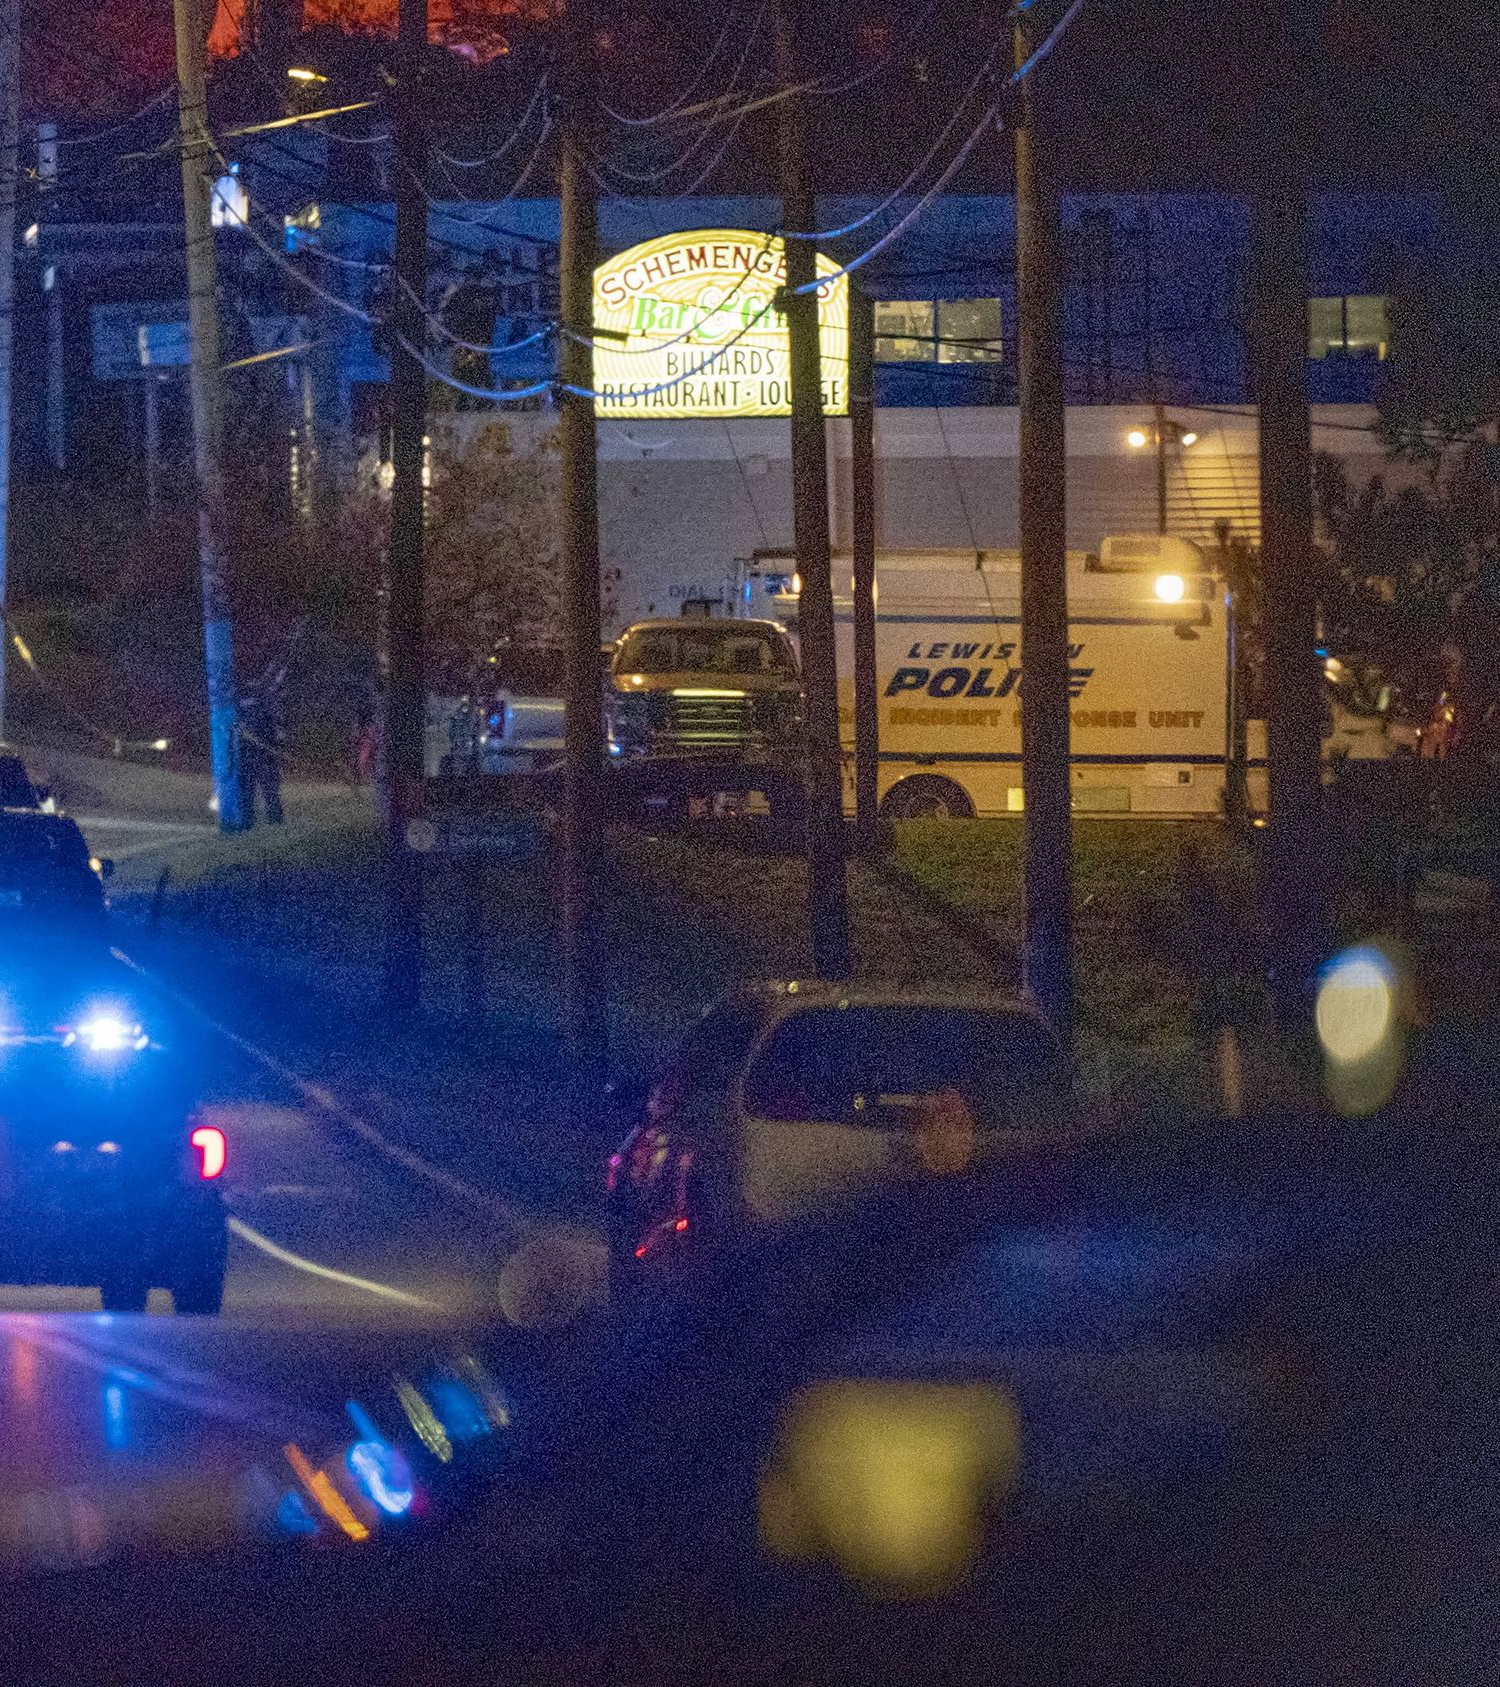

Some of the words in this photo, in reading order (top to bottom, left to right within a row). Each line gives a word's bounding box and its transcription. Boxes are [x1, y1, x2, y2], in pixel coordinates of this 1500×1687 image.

[601, 245, 835, 305] SCHEMENGES
[634, 297, 689, 330] Bar
[667, 350, 775, 376] BILLIARDS
[602, 380, 741, 408] RESTAURANT
[761, 380, 840, 406] LOUGE
[908, 641, 1085, 660] LEWISN
[884, 666, 1095, 698] POLIE
[1149, 710, 1205, 728] UNIT
